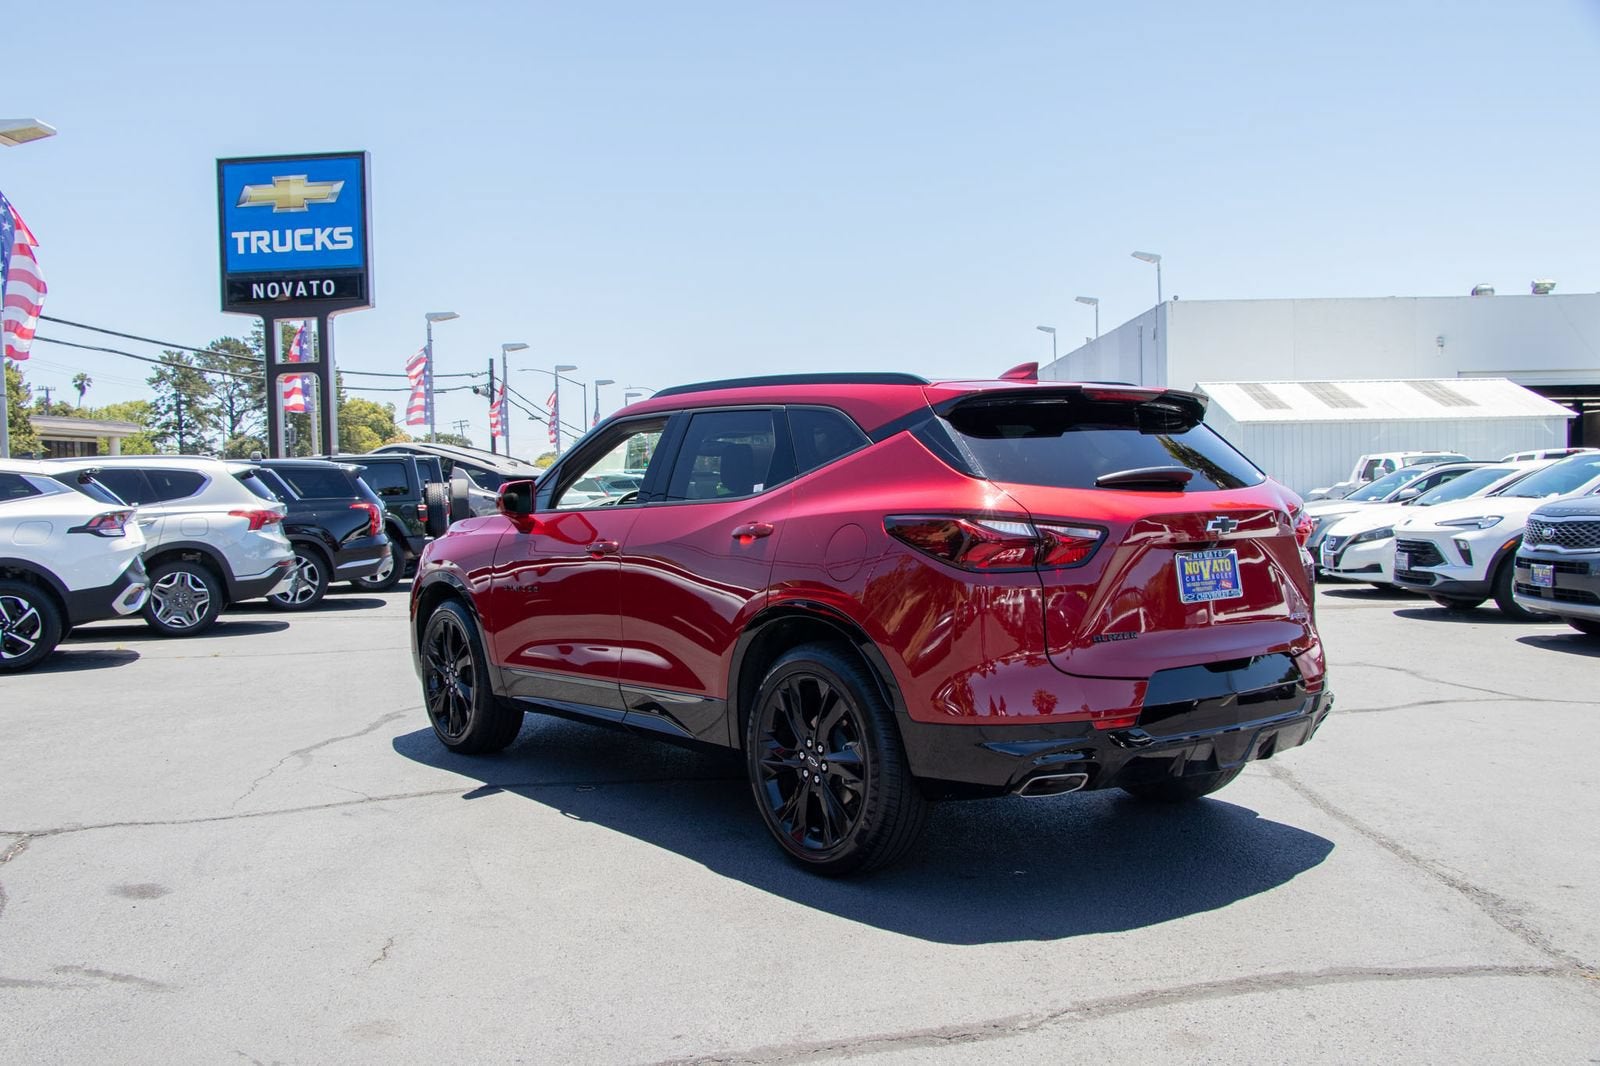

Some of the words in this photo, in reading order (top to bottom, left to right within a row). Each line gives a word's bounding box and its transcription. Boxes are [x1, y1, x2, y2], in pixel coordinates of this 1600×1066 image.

[231, 226, 354, 255] TRUCKS
[252, 279, 336, 299] NOVATO
[1184, 559, 1232, 580] NOVATO
